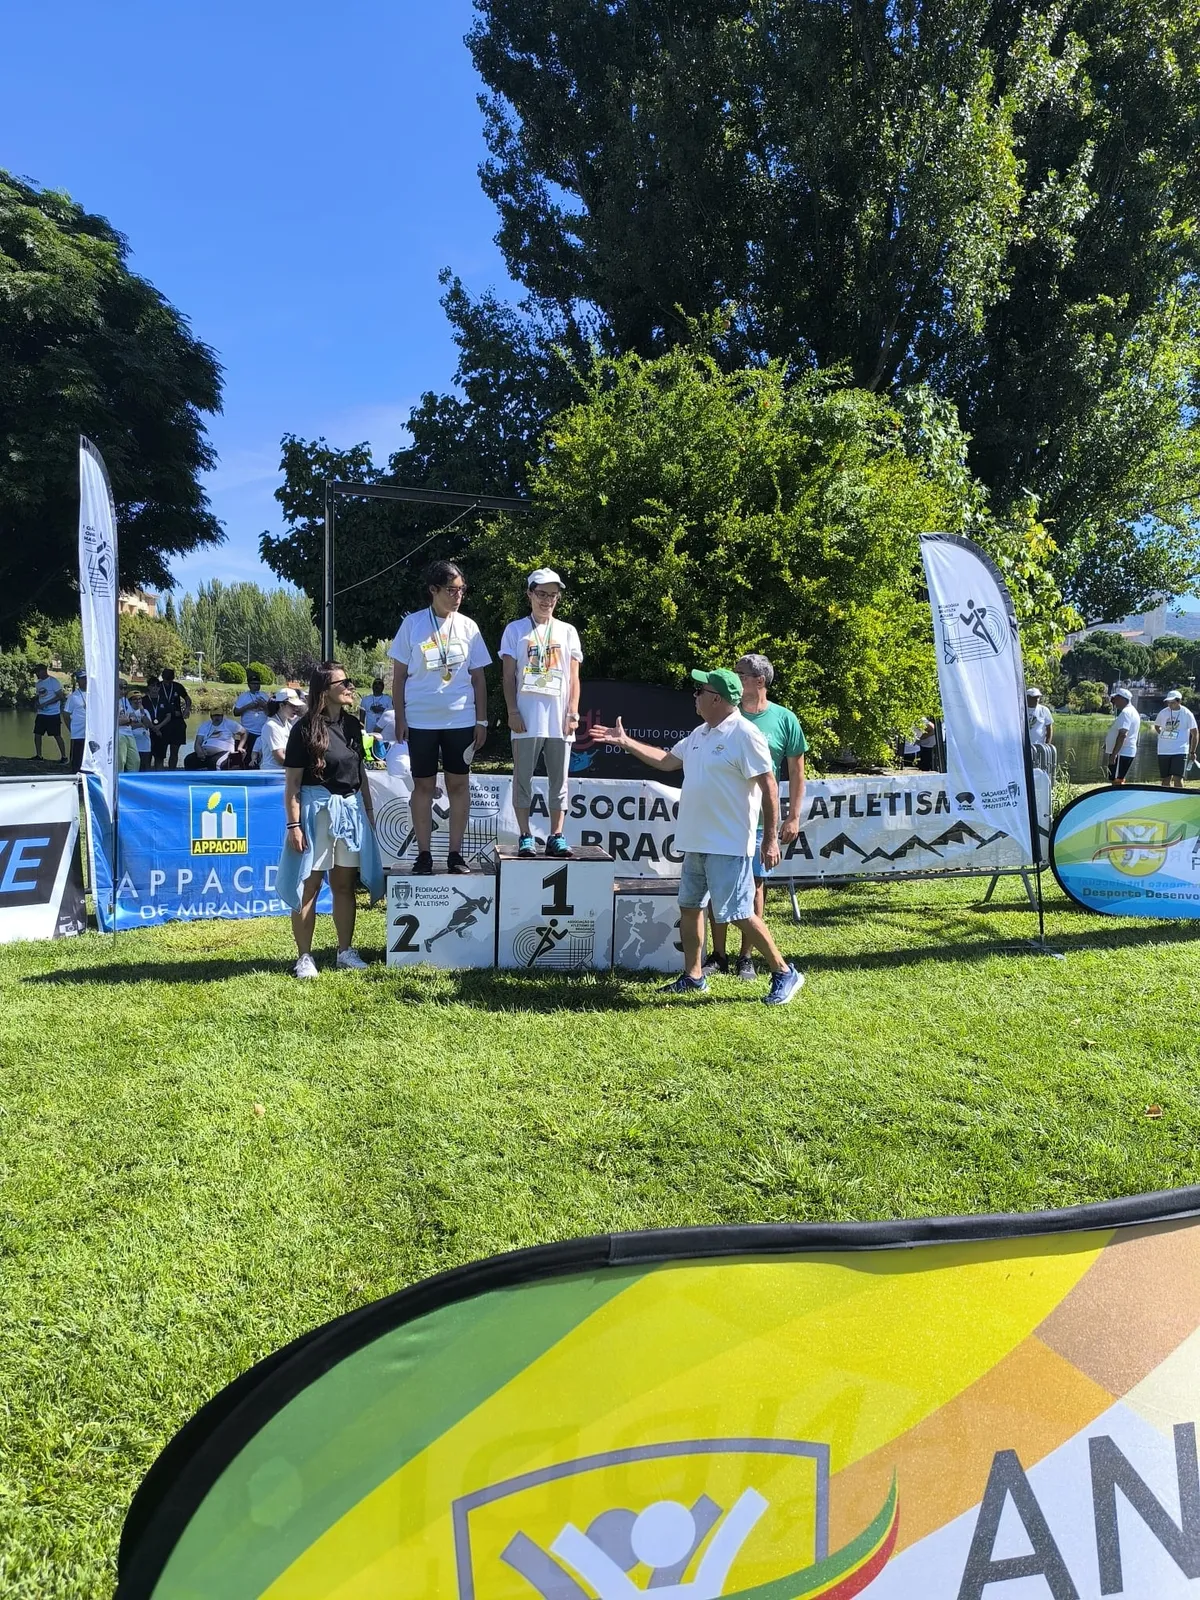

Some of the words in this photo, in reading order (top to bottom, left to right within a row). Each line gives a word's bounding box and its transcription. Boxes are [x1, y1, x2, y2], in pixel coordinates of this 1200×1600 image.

[605, 744, 622, 754] DO
[529, 793, 680, 822] ASOCIA
[193, 840, 247, 854] APPACDM
[415, 886, 450, 894] FEDERAÇÃO
[541, 863, 575, 916] 1
[1082, 887, 1142, 899] Desporto
[140, 903, 170, 920] DE
[177, 898, 293, 917] MIRANDEL
[389, 914, 420, 952] 2
